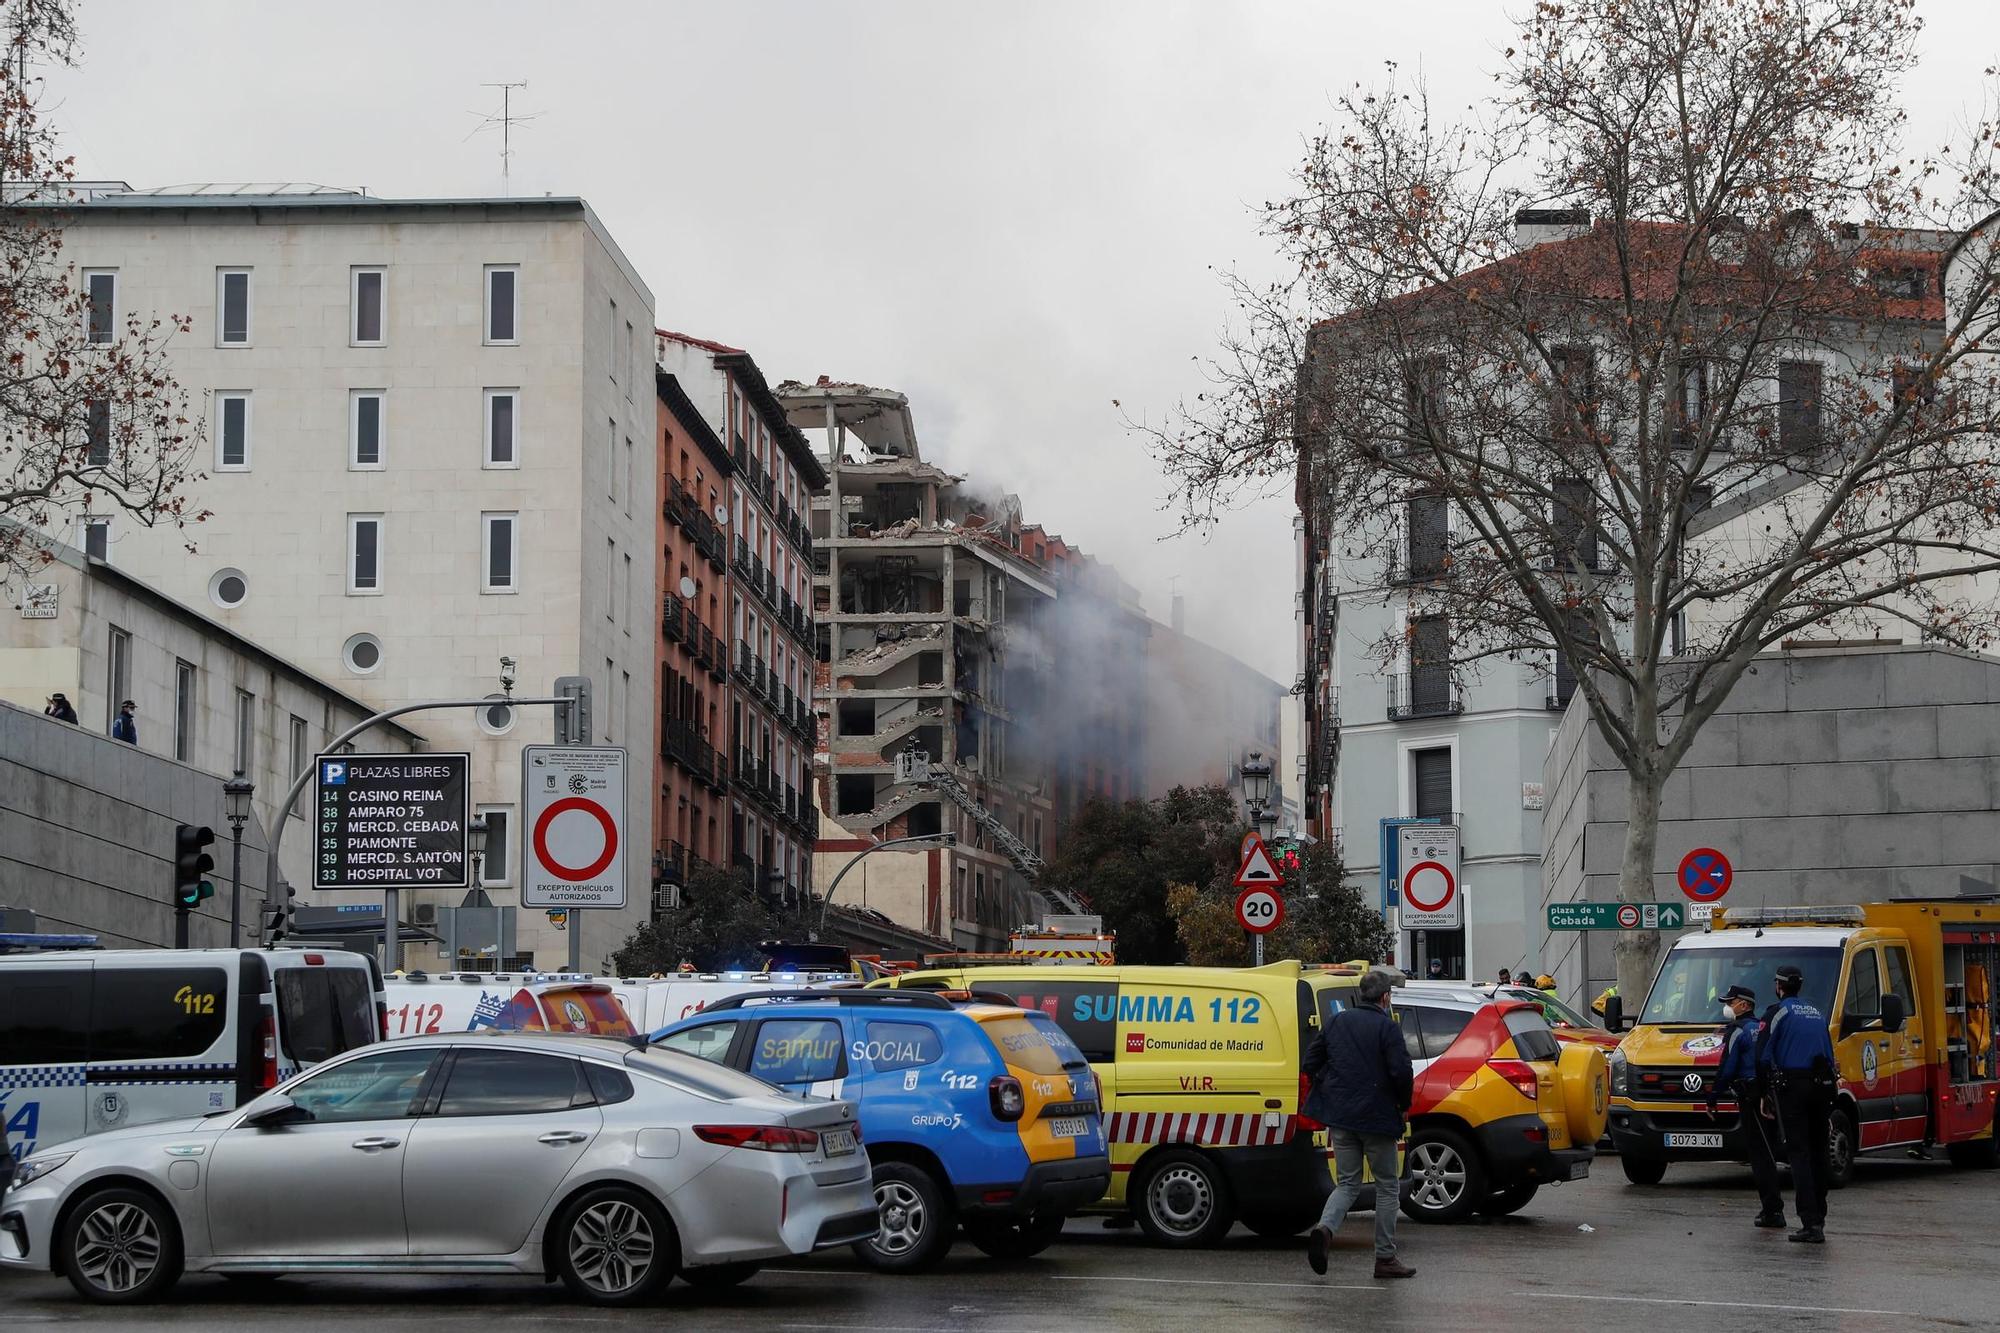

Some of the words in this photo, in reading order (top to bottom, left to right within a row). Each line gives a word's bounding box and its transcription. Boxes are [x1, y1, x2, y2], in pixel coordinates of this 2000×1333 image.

[327, 764, 342, 783] P
[350, 767, 400, 778] PLAZAS
[404, 766, 450, 778] LIBRES
[323, 791, 338, 802] 14
[348, 791, 399, 801] CASINO
[403, 790, 444, 801] REINA
[323, 807, 338, 818] 38
[348, 807, 406, 818] AMPARO
[409, 806, 424, 817] 75
[322, 822, 338, 833] 67
[348, 821, 400, 832] MERCD.
[403, 821, 459, 832] CEBADA
[322, 838, 338, 849] 35
[348, 837, 417, 849] PIAMONTE
[322, 853, 337, 864] 39
[347, 852, 399, 864] MERCD.
[403, 850, 462, 863] S.ANTÓN
[322, 870, 337, 880] 33
[347, 868, 412, 880] HOSPITAL
[416, 868, 443, 879] VOT
[572, 884, 614, 892] VEHÍCULOS
[1246, 901, 1273, 917] 20
[1551, 906, 1575, 915] plaza
[1580, 906, 1592, 914] de
[1596, 906, 1605, 914] la
[1552, 915, 1595, 925] Cebada
[183, 993, 215, 1014] 112
[1073, 995, 1195, 1022] SUMMA
[1209, 997, 1261, 1023] 112
[399, 1003, 443, 1035] 112
[762, 1039, 840, 1060] samur
[851, 1041, 926, 1062] SOCIAL
[1146, 1038, 1207, 1050] Comunidad
[1210, 1039, 1222, 1050] de
[1226, 1040, 1263, 1051] Madrid
[947, 1075, 978, 1089] 112
[1179, 1076, 1217, 1091] V.I.R.
[1036, 1083, 1053, 1096] 112
[1054, 1120, 1072, 1135] 6833
[1671, 1135, 1697, 1145] 3073
[1701, 1135, 1720, 1145] JKY
